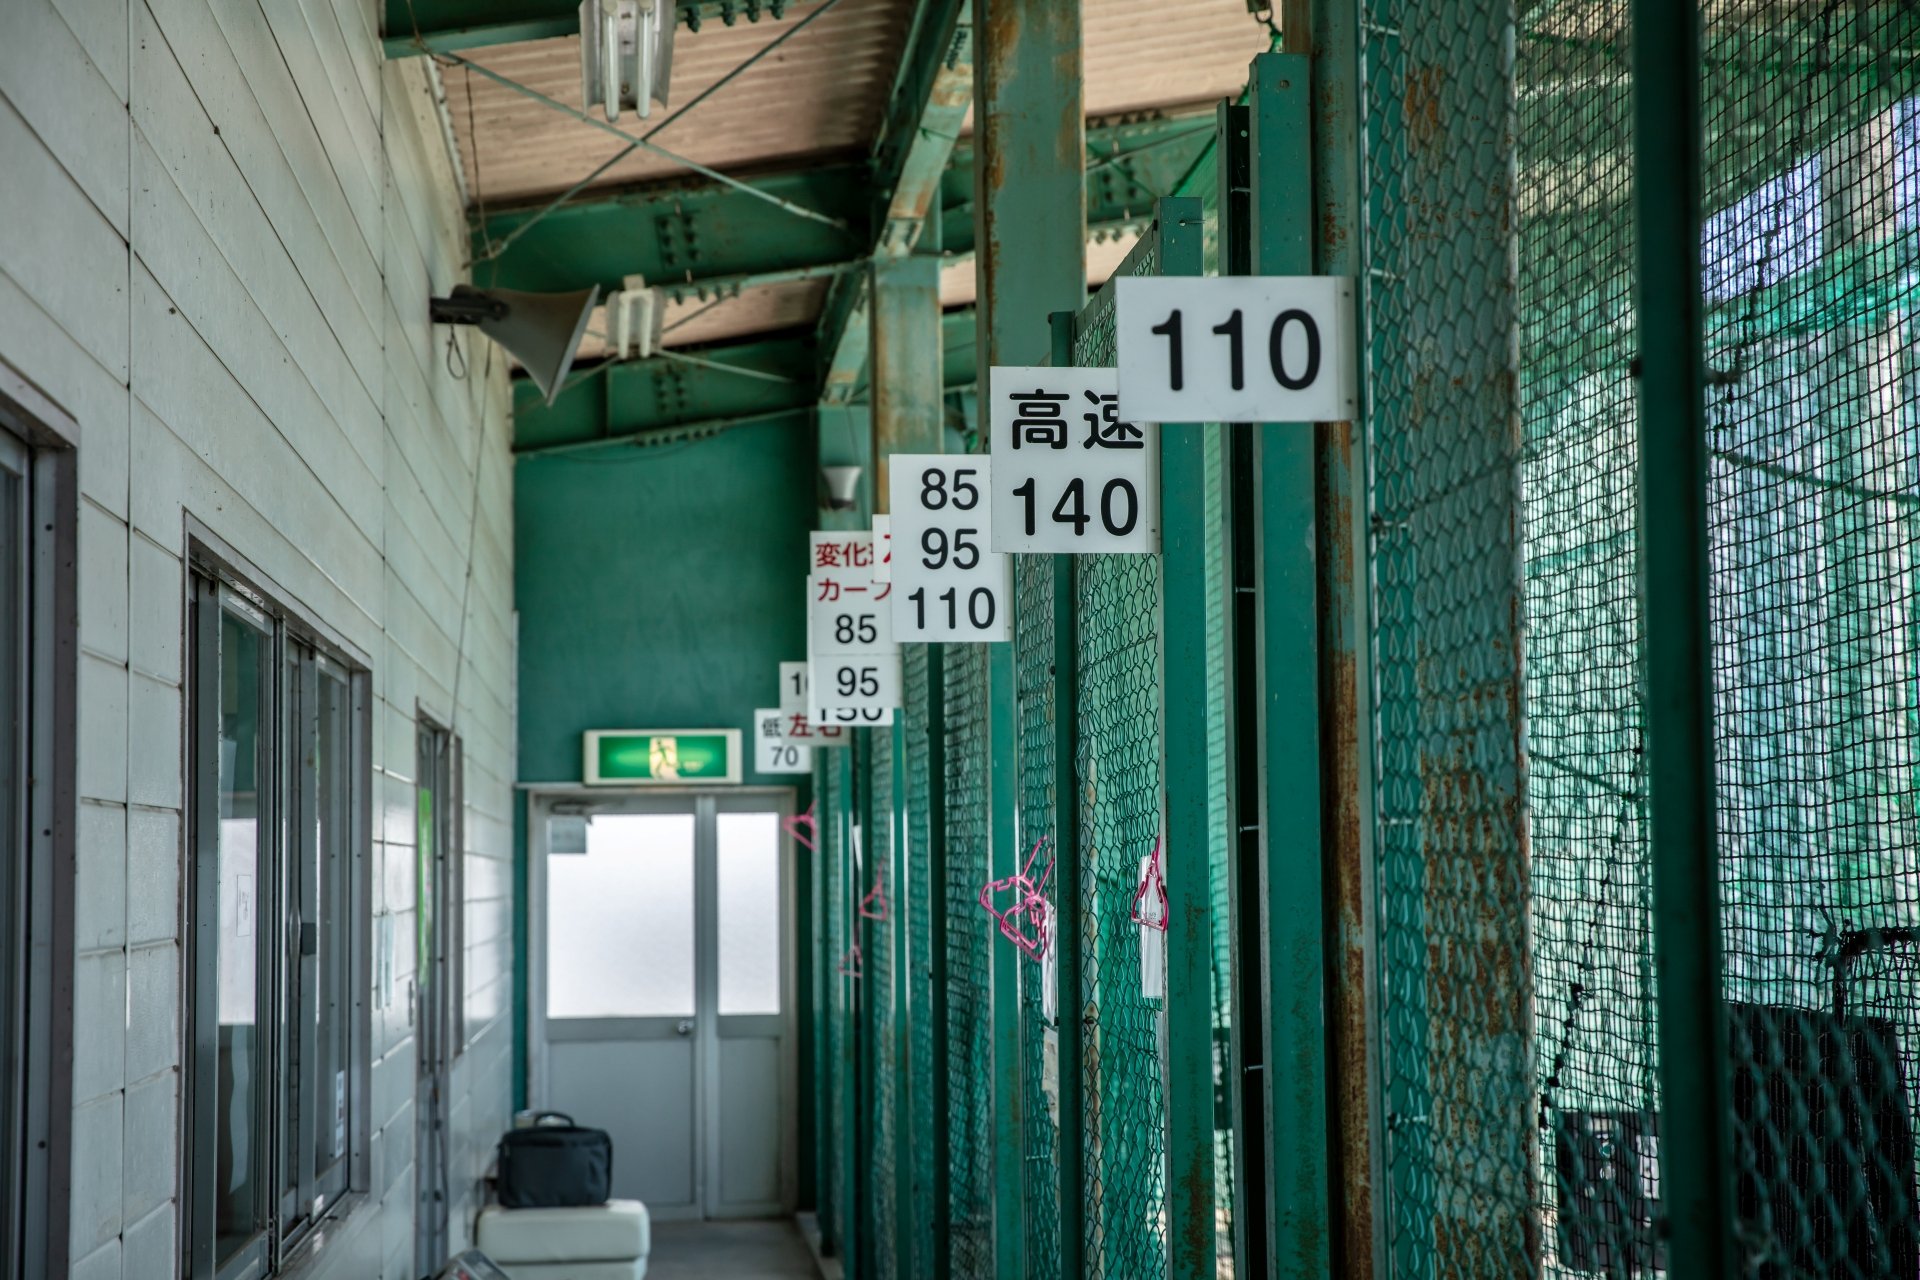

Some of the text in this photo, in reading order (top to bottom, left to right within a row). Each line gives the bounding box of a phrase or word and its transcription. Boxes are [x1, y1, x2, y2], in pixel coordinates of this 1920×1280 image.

[1152, 309, 1321, 391] 110
[1009, 389, 1145, 450] 高速
[921, 468, 978, 510] 85
[1013, 478, 1138, 536] 140
[816, 543, 873, 567] 変化
[922, 528, 979, 570] 95
[835, 614, 877, 644] 85
[908, 587, 995, 629] 110
[837, 667, 878, 696] 95
[771, 745, 799, 767] 70
